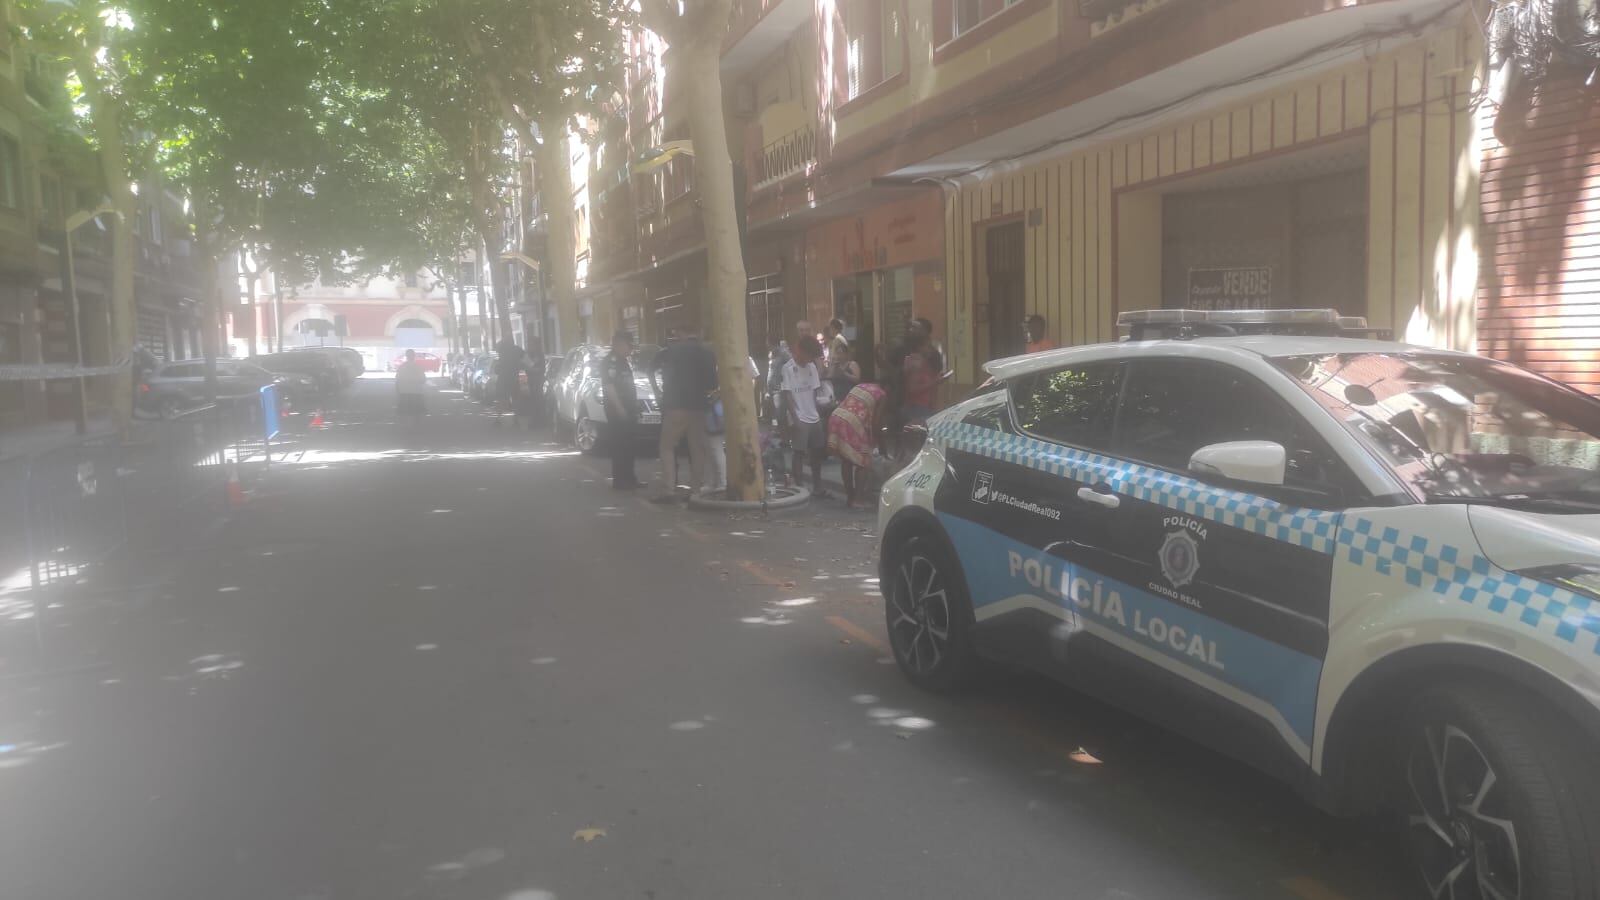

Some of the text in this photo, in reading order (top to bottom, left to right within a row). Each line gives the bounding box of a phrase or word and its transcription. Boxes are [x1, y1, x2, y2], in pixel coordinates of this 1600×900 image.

[1223, 270, 1268, 296] VENDE
[904, 472, 932, 489] A-02
[996, 493, 1061, 520] @PLCiudadReal092
[1163, 516, 1208, 540] POLICÍA
[1148, 581, 1203, 609] CIUDAD REAL
[1008, 550, 1224, 670] POLICÍA LOCAL
